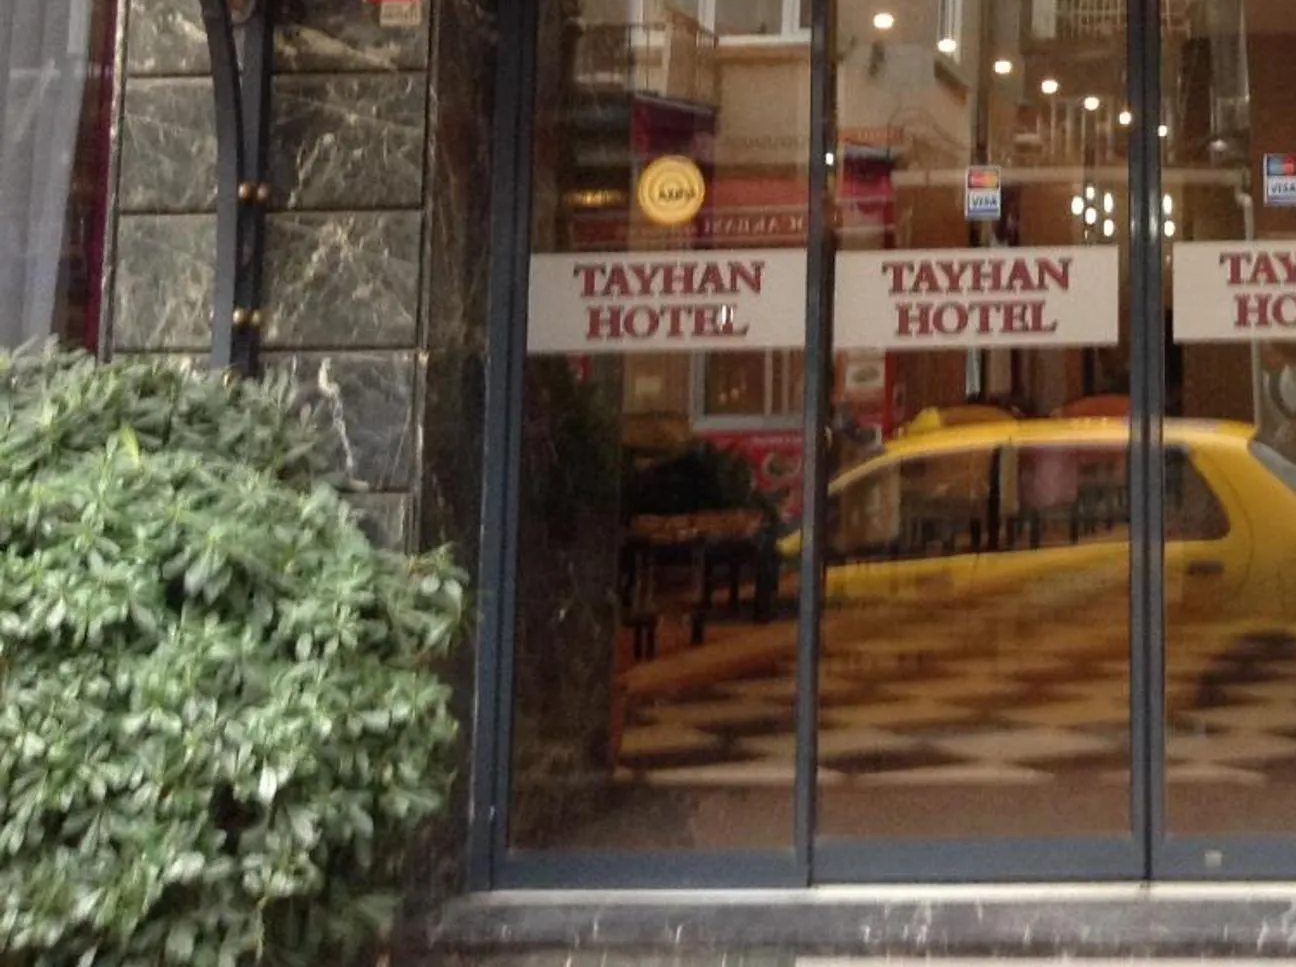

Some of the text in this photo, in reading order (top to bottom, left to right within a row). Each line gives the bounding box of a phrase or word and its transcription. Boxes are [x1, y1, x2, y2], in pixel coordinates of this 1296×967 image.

[971, 194, 997, 206] VISA
[1270, 182, 1296, 194] VISA
[573, 259, 766, 298] TAYHAN
[881, 257, 1072, 295] TAYHAN
[585, 302, 750, 341] HOTEL
[895, 299, 1059, 337] HOTEL
